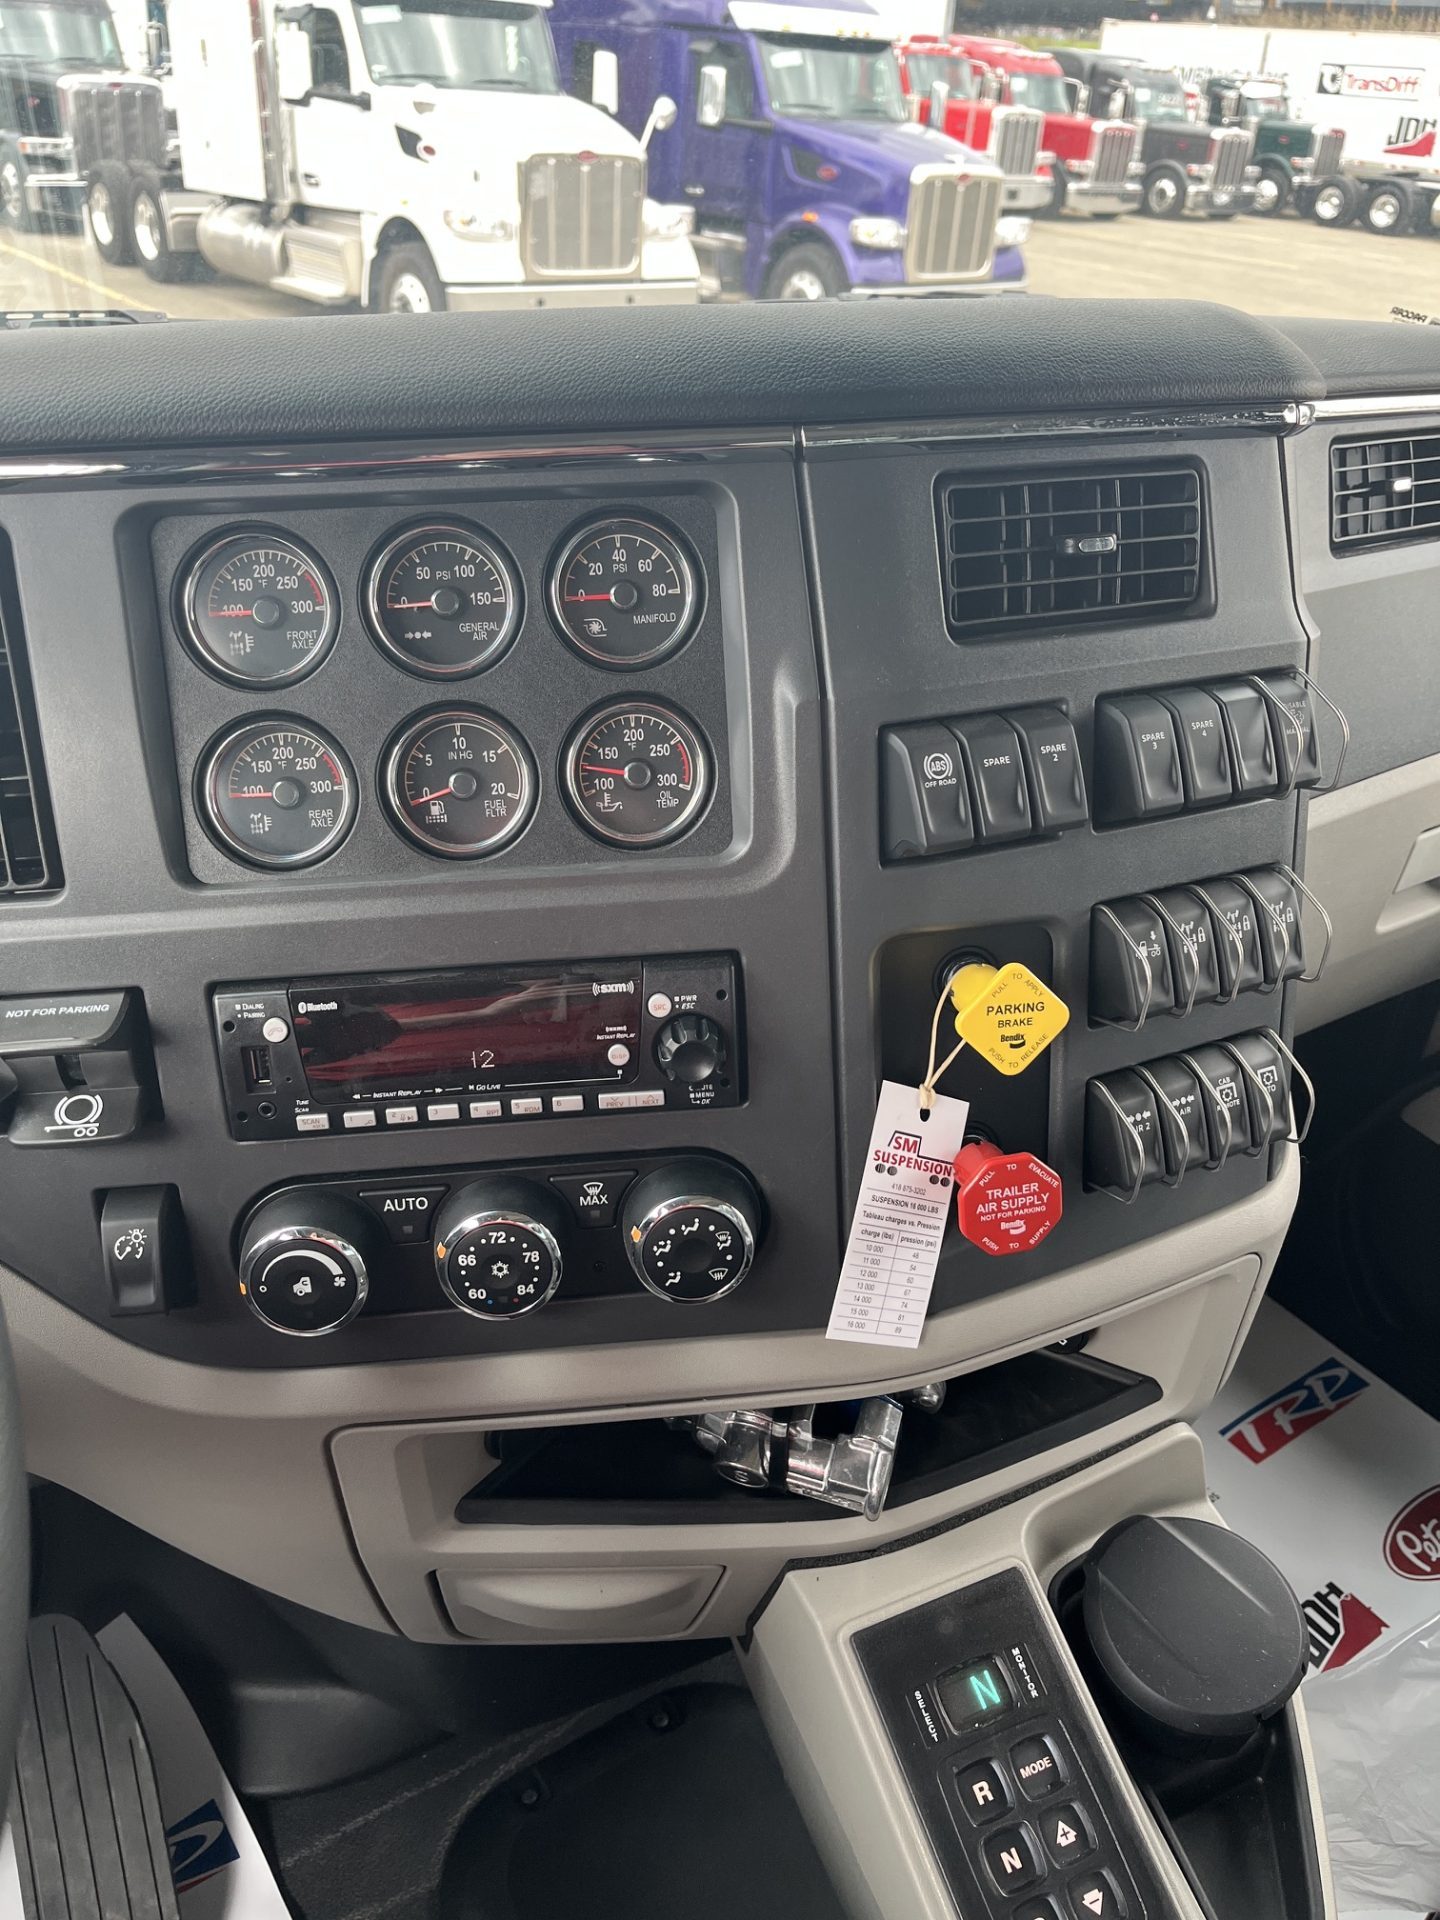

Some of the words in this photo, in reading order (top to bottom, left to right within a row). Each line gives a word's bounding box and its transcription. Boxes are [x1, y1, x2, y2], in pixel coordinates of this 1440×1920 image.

[612, 549, 626, 562] 40
[252, 564, 274, 578] 200
[454, 564, 475, 578] 100
[588, 562, 602, 576] 20
[612, 563, 628, 573] PSI
[638, 559, 652, 572] 60
[416, 566, 430, 580] 50
[436, 569, 450, 581] PSI
[232, 578, 252, 592] 150
[276, 576, 298, 590] 250
[652, 584, 666, 597] 80
[470, 592, 491, 606] 150
[291, 600, 313, 614] 300
[633, 612, 676, 624] MANIFOLD
[286, 630, 318, 640] FRONT
[458, 622, 500, 634] GENERAL
[472, 631, 488, 641] AIR
[292, 640, 314, 649] AXLE
[1191, 719, 1214, 730] SPARE
[623, 728, 644, 742] 200
[1142, 731, 1166, 743] SPARE
[1202, 730, 1207, 738] 4
[452, 736, 467, 750] 10
[1040, 743, 1067, 754] SPARE
[1152, 742, 1158, 750] 3
[272, 746, 294, 760] 200
[448, 752, 458, 761] IN
[458, 750, 474, 760] HG
[482, 750, 497, 764] 15
[598, 746, 618, 760] 150
[650, 744, 670, 757] 250
[295, 757, 317, 771] 250
[425, 754, 432, 768] 5
[984, 756, 1011, 768] SPARE
[1052, 754, 1058, 762] 2
[251, 760, 272, 774] 150
[930, 759, 946, 772] ABS
[310, 780, 332, 794] 300
[594, 778, 614, 790] 100
[657, 773, 678, 787] 300
[924, 780, 938, 788] OFF
[938, 778, 957, 786] ROAD
[490, 782, 506, 796] 20
[660, 790, 672, 800] OIL
[484, 800, 507, 810] FUEL
[656, 798, 680, 808] TEMP
[308, 808, 333, 820] REAR
[485, 808, 508, 818] FLTR
[310, 818, 334, 828] AXLE
[992, 982, 1008, 998] PULL
[1012, 972, 1023, 980] TO
[1024, 980, 1044, 998] APPLY
[5, 1009, 30, 1019] NOT
[32, 1007, 57, 1017] FOR
[58, 1004, 110, 1016] PARKING
[306, 1001, 338, 1012] Bluetooth
[682, 1002, 696, 1010] ESC
[986, 1001, 1045, 1016] PARKING
[998, 1017, 1033, 1028] BRAKE
[1000, 1033, 1025, 1043] Bendix
[988, 1048, 1005, 1064] PUSH
[1020, 1034, 1048, 1061] RELEASE
[471, 1050, 496, 1069] 12
[1218, 1076, 1231, 1085] CAB
[1180, 1106, 1192, 1116] AIR
[893, 1136, 918, 1154] SM
[873, 1150, 952, 1177] SUSPENSION
[979, 1170, 996, 1186] PULL
[1028, 1162, 1059, 1188] EVACUATE
[986, 1182, 1039, 1200] TRAILER
[383, 1196, 428, 1212] AUTO
[579, 1193, 609, 1207] MAX
[872, 1194, 909, 1208] SUSPENSION
[928, 1206, 939, 1214] LBS
[976, 1202, 998, 1214] AIR
[1001, 1193, 1050, 1210] SUPPLY
[863, 1210, 884, 1220] Tableau
[885, 1215, 907, 1226] charges
[916, 1220, 940, 1230] Pression
[980, 1214, 996, 1222] NOT
[998, 1211, 1012, 1219] FOR
[1014, 1206, 1046, 1216] PARKING
[1000, 1220, 1025, 1230] Bendix
[488, 1231, 507, 1245] 72
[861, 1228, 881, 1238] charge
[900, 1236, 924, 1244] pression
[982, 1236, 1000, 1252] PUSH
[1009, 1242, 1020, 1250] TO
[1029, 1220, 1051, 1245] SUPPLY
[458, 1254, 476, 1267] 66
[522, 1250, 540, 1264] 78
[468, 1288, 487, 1300] 60
[516, 1284, 536, 1296] 84
[1396, 1518, 1440, 1573] Pet
[1011, 1647, 1039, 1699] MONITOR
[969, 1669, 1001, 1711] N
[914, 1690, 939, 1743] SELECT
[1019, 1756, 1053, 1780] MODE
[971, 1780, 995, 1806] R
[1000, 1847, 1023, 1874] N
